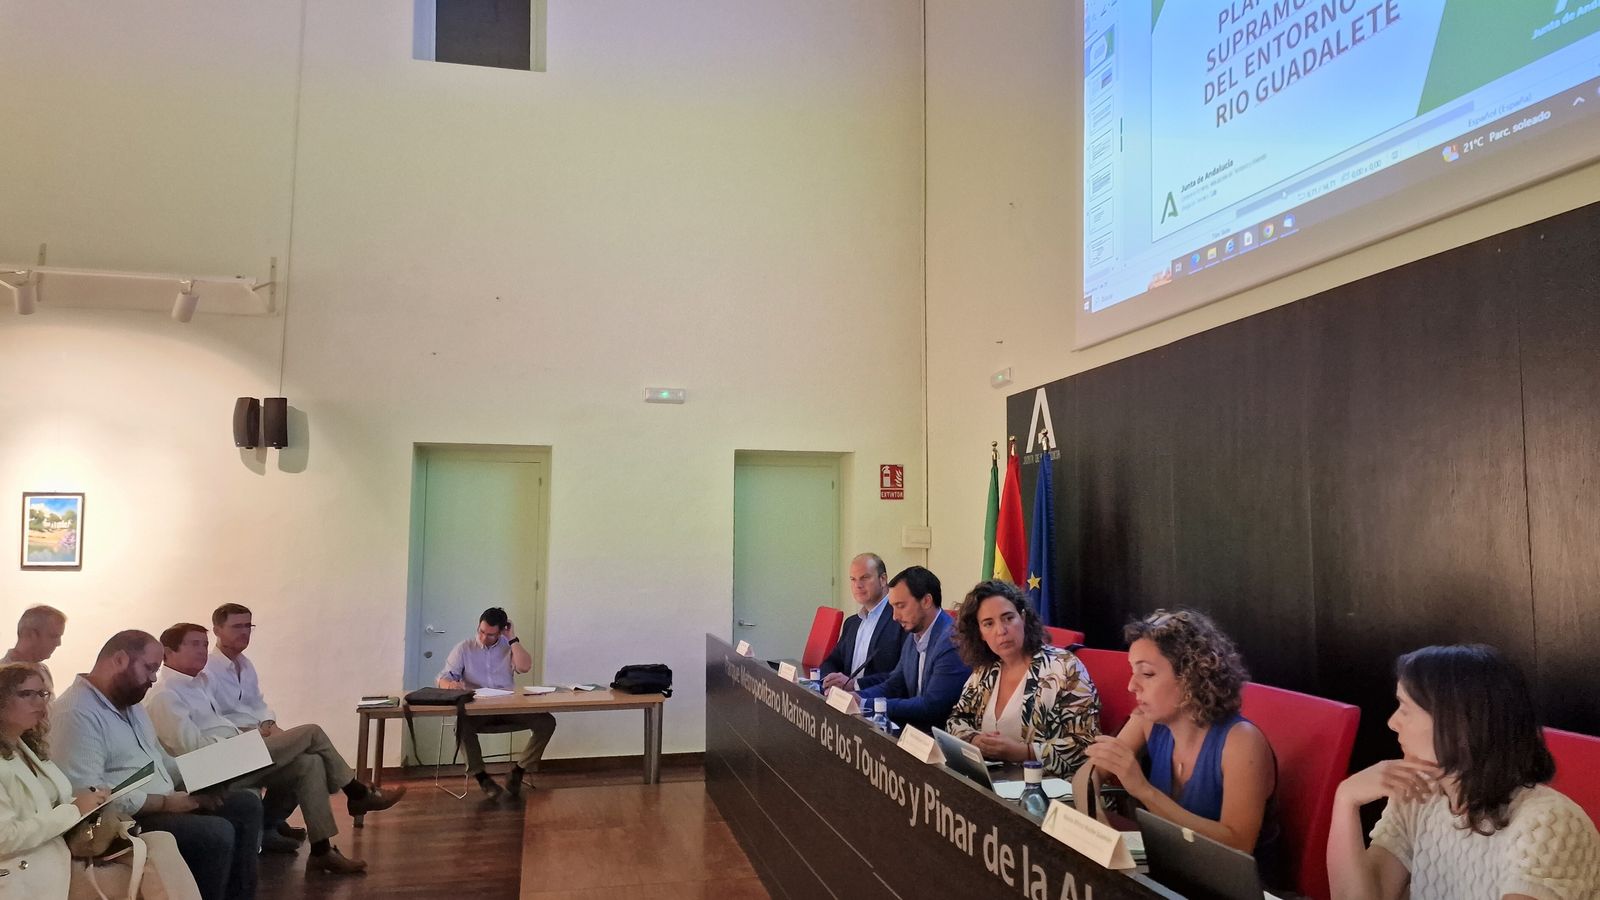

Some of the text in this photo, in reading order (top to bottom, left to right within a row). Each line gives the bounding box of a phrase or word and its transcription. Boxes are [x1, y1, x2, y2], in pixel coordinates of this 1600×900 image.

[1218, 0, 1259, 34] PLA
[1216, 0, 1401, 128] RIO GUADALETE
[1204, 67, 1239, 105] DEL
[1489, 127, 1511, 142] Parc.
[1512, 110, 1552, 133] soleado
[781, 691, 816, 738] Marisma
[820, 717, 834, 752] de
[835, 723, 852, 764] los
[908, 782, 920, 828] y
[924, 782, 977, 857] Pinar
[983, 825, 1015, 888] de
[1022, 844, 1048, 900] la
